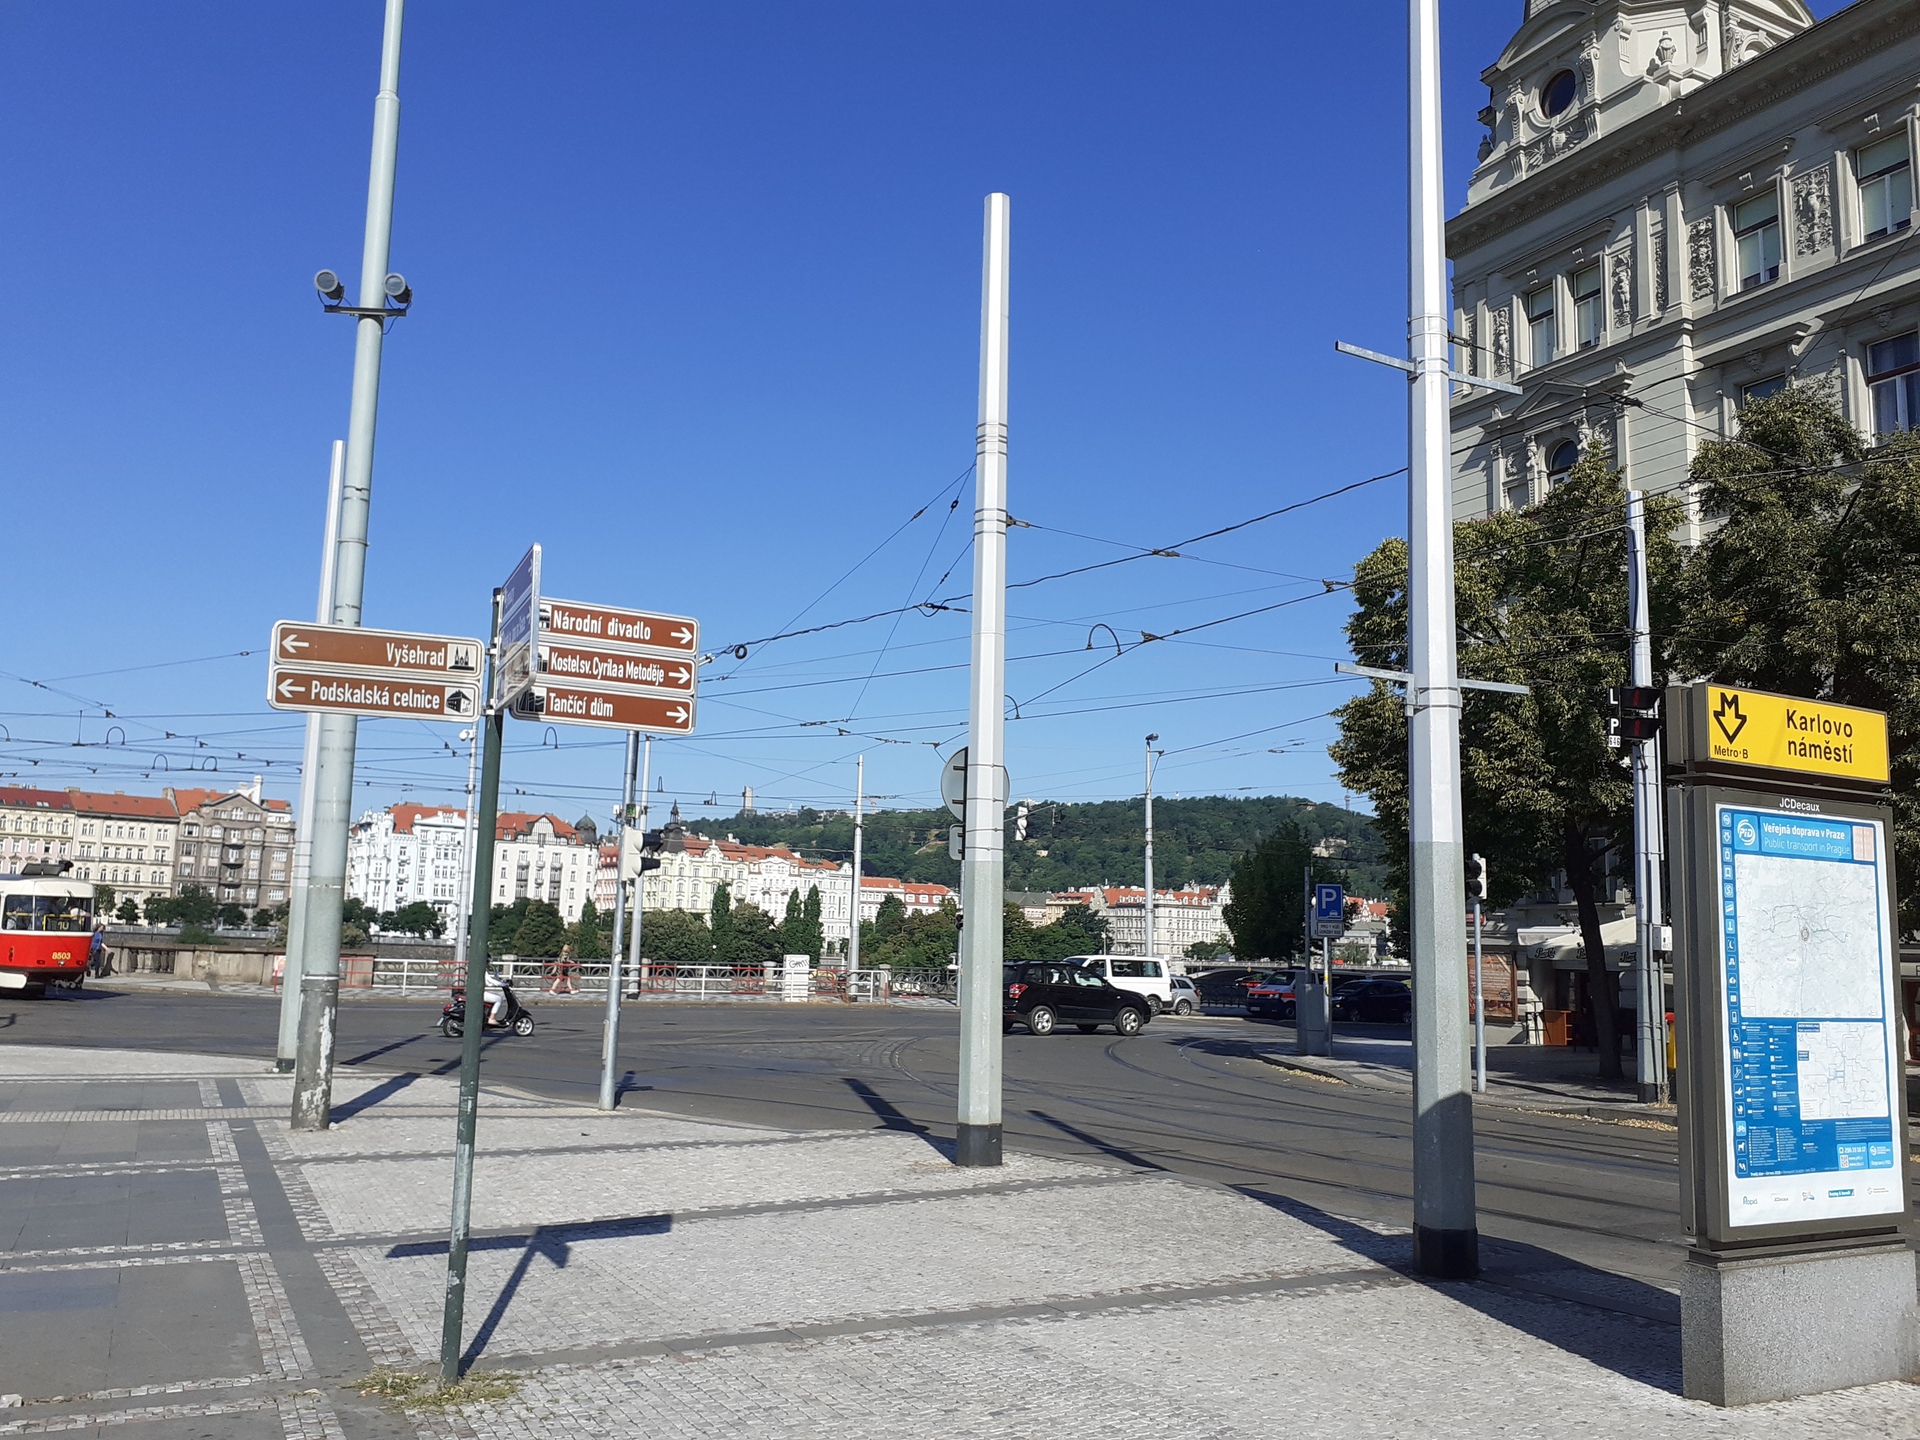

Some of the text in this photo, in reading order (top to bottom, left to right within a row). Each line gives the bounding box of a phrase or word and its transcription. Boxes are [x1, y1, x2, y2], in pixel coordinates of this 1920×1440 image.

[553, 609, 603, 635] Národní
[607, 617, 652, 640] divadlo
[386, 641, 445, 667] Vyšehrad
[625, 660, 665, 686] Metoděje
[311, 679, 441, 710] Podskalská celnice
[549, 692, 614, 718] Tančící dům
[1610, 688, 1618, 704] L
[1611, 718, 1619, 734] P
[1786, 708, 1854, 738] Karlovo
[1787, 736, 1854, 764] náměstí
[1779, 797, 1821, 812] JCDecaux
[1762, 822, 1791, 836] Veřejná
[1791, 825, 1821, 839] doprava
[1825, 828, 1846, 840] Praze
[1764, 837, 1785, 849] Public
[1787, 840, 1819, 853] transport
[1826, 843, 1851, 856] Prague
[1321, 888, 1337, 909] P
[52, 951, 71, 960] 8503
